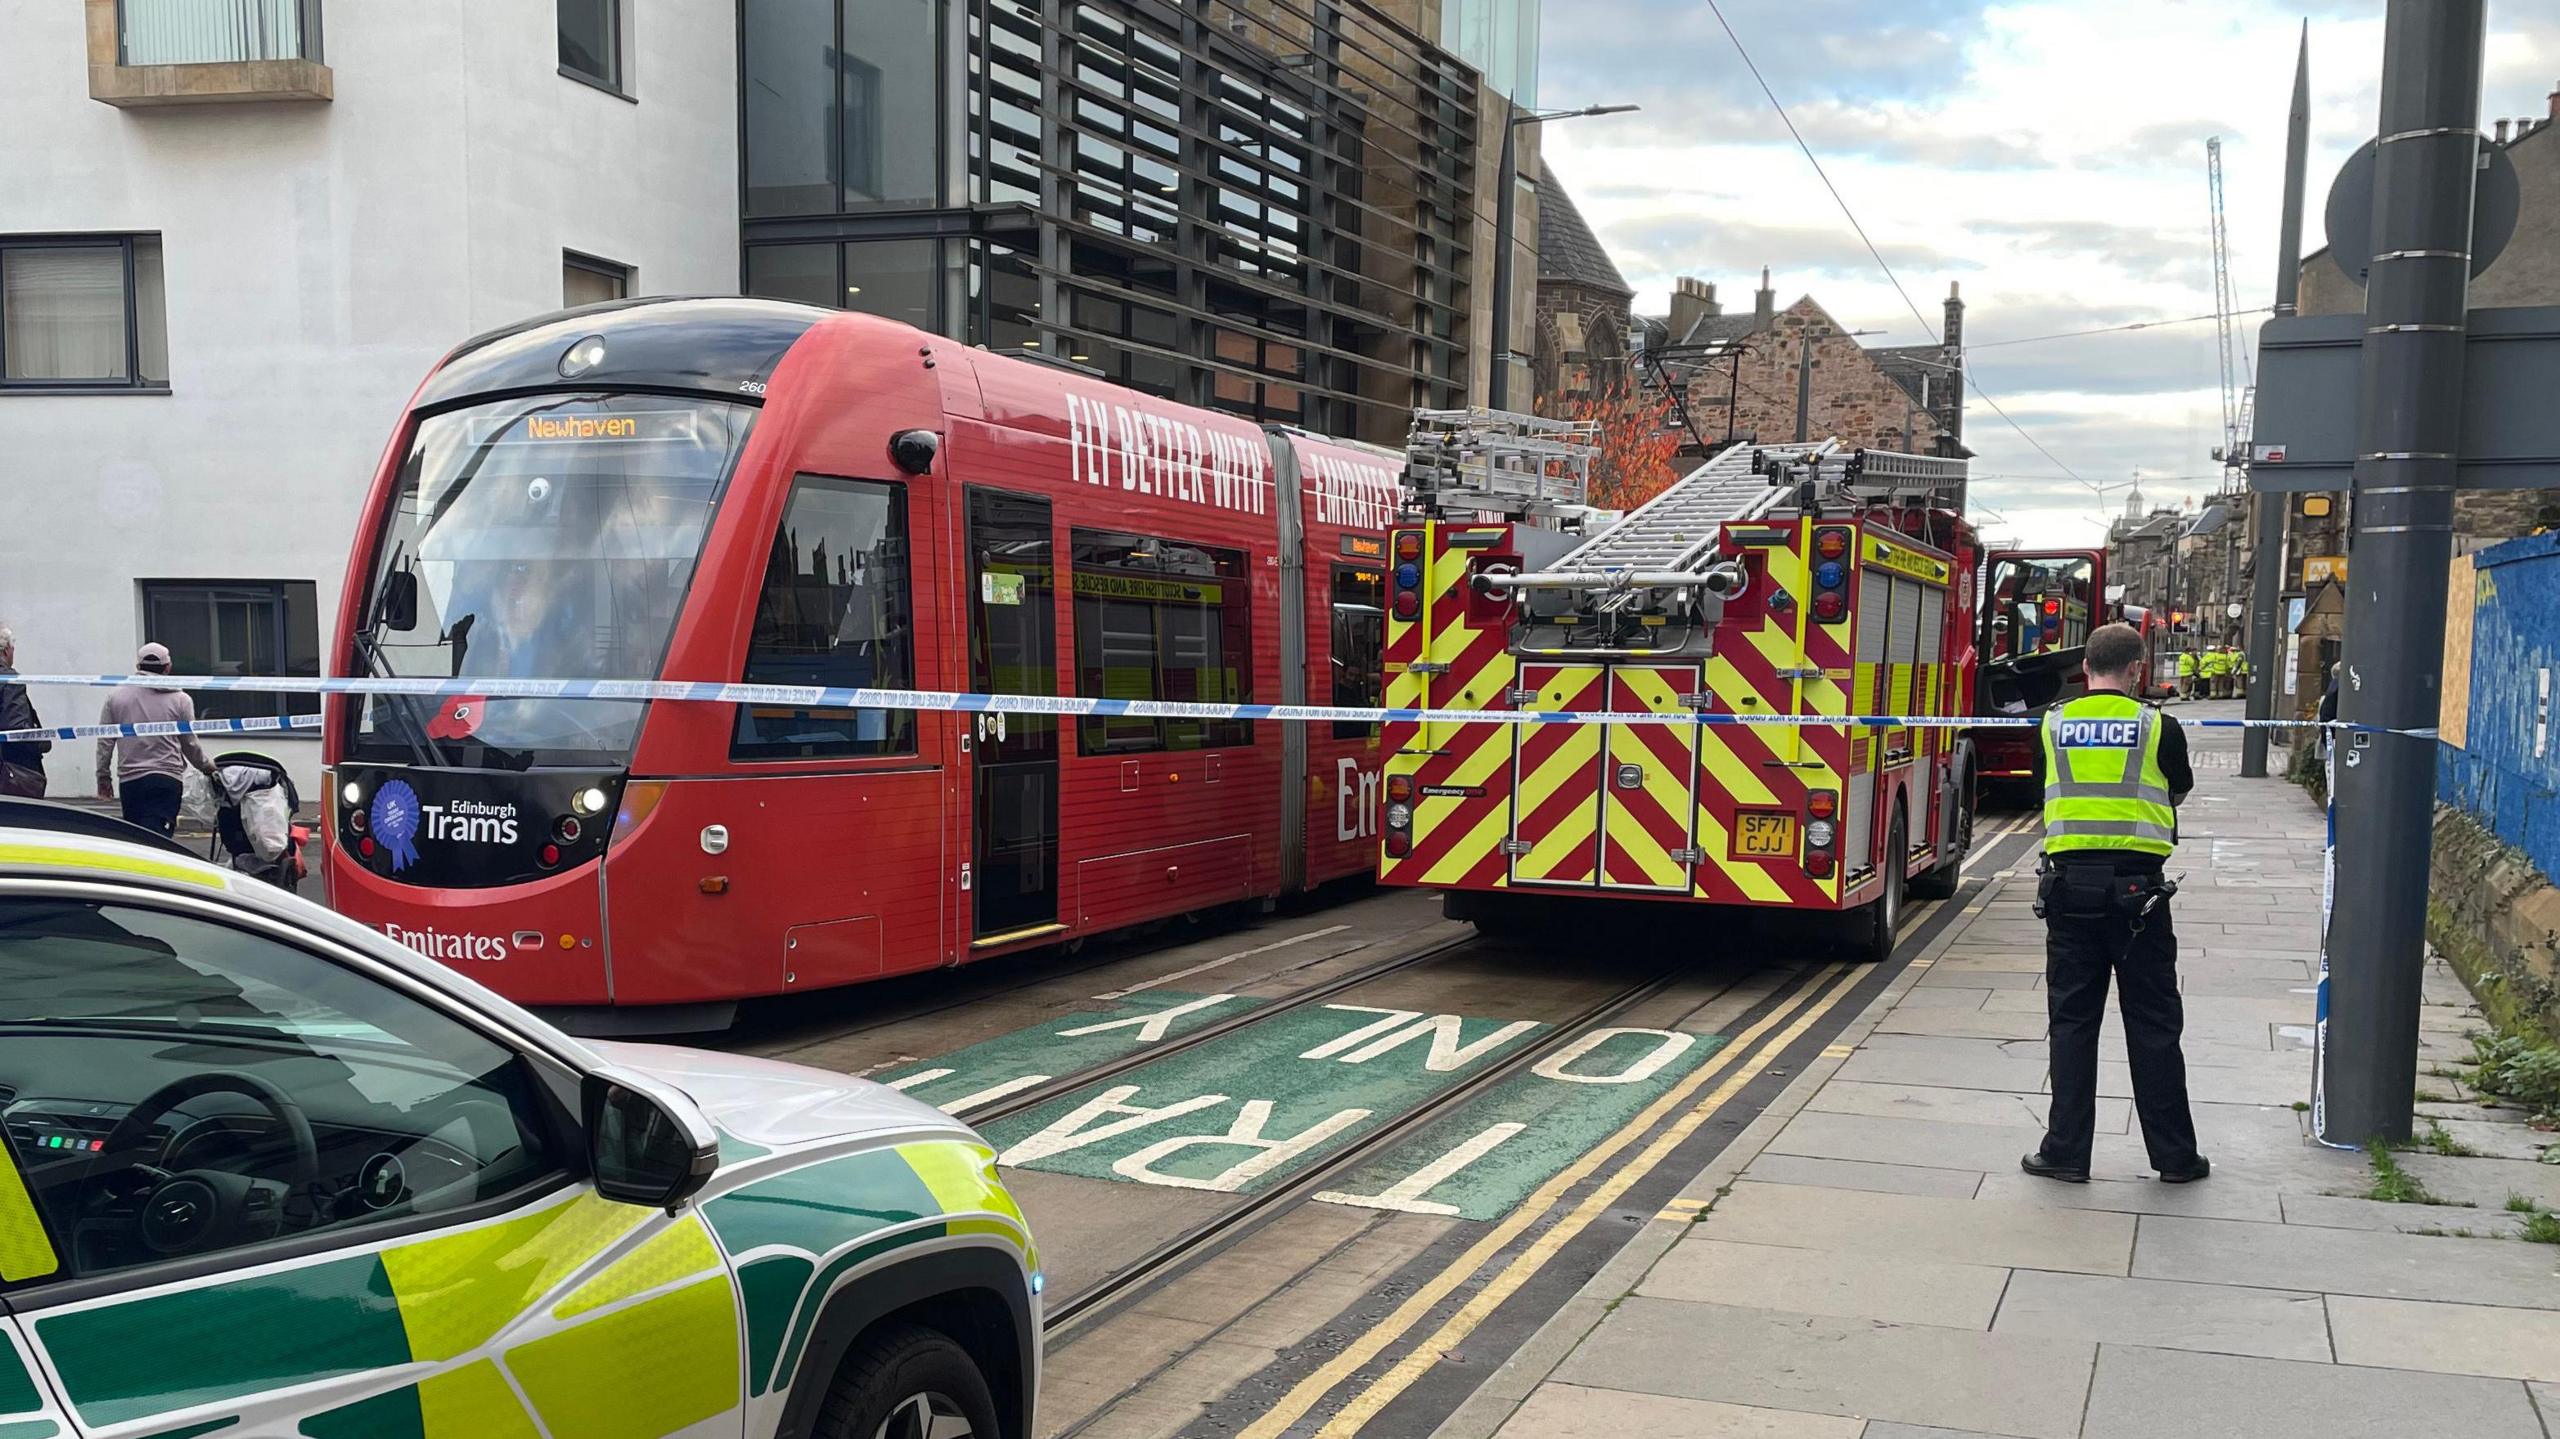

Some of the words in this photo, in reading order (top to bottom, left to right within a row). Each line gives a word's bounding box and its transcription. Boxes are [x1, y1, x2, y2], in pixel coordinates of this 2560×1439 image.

[739, 380, 767, 394] 260
[528, 416, 636, 439] Newhaven
[1066, 393, 1110, 487] FLY
[1114, 406, 1206, 505] BETTER
[1206, 429, 1265, 515] WITH
[1309, 453, 1393, 531] EMIRATES
[2061, 722, 2137, 744] POLICE
[1422, 786, 1465, 796] Emergency
[451, 800, 516, 819] Edinburgh
[422, 805, 518, 844] Trams
[1745, 816, 1786, 834] SF71
[1747, 835, 1783, 852] CJJ
[385, 922, 507, 960] Emirates
[1055, 993, 1697, 1083] ONLY
